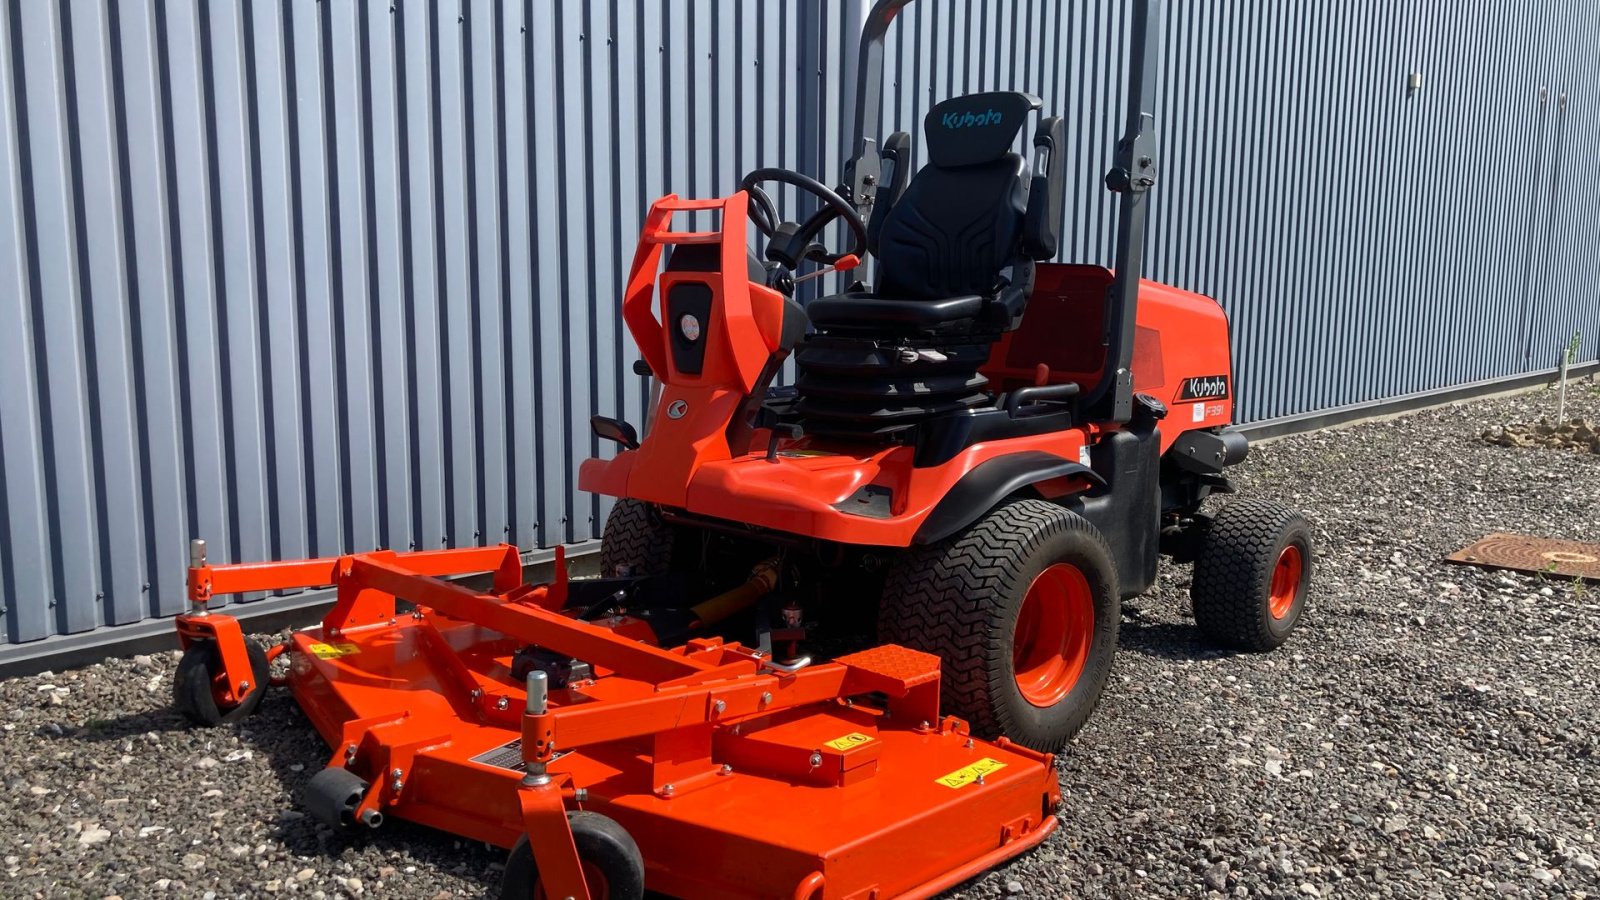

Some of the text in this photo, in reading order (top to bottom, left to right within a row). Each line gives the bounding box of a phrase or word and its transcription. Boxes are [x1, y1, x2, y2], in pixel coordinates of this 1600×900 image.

[942, 108, 1002, 128] Kubota
[1190, 376, 1225, 397] Kubota
[1205, 404, 1224, 417] F391
